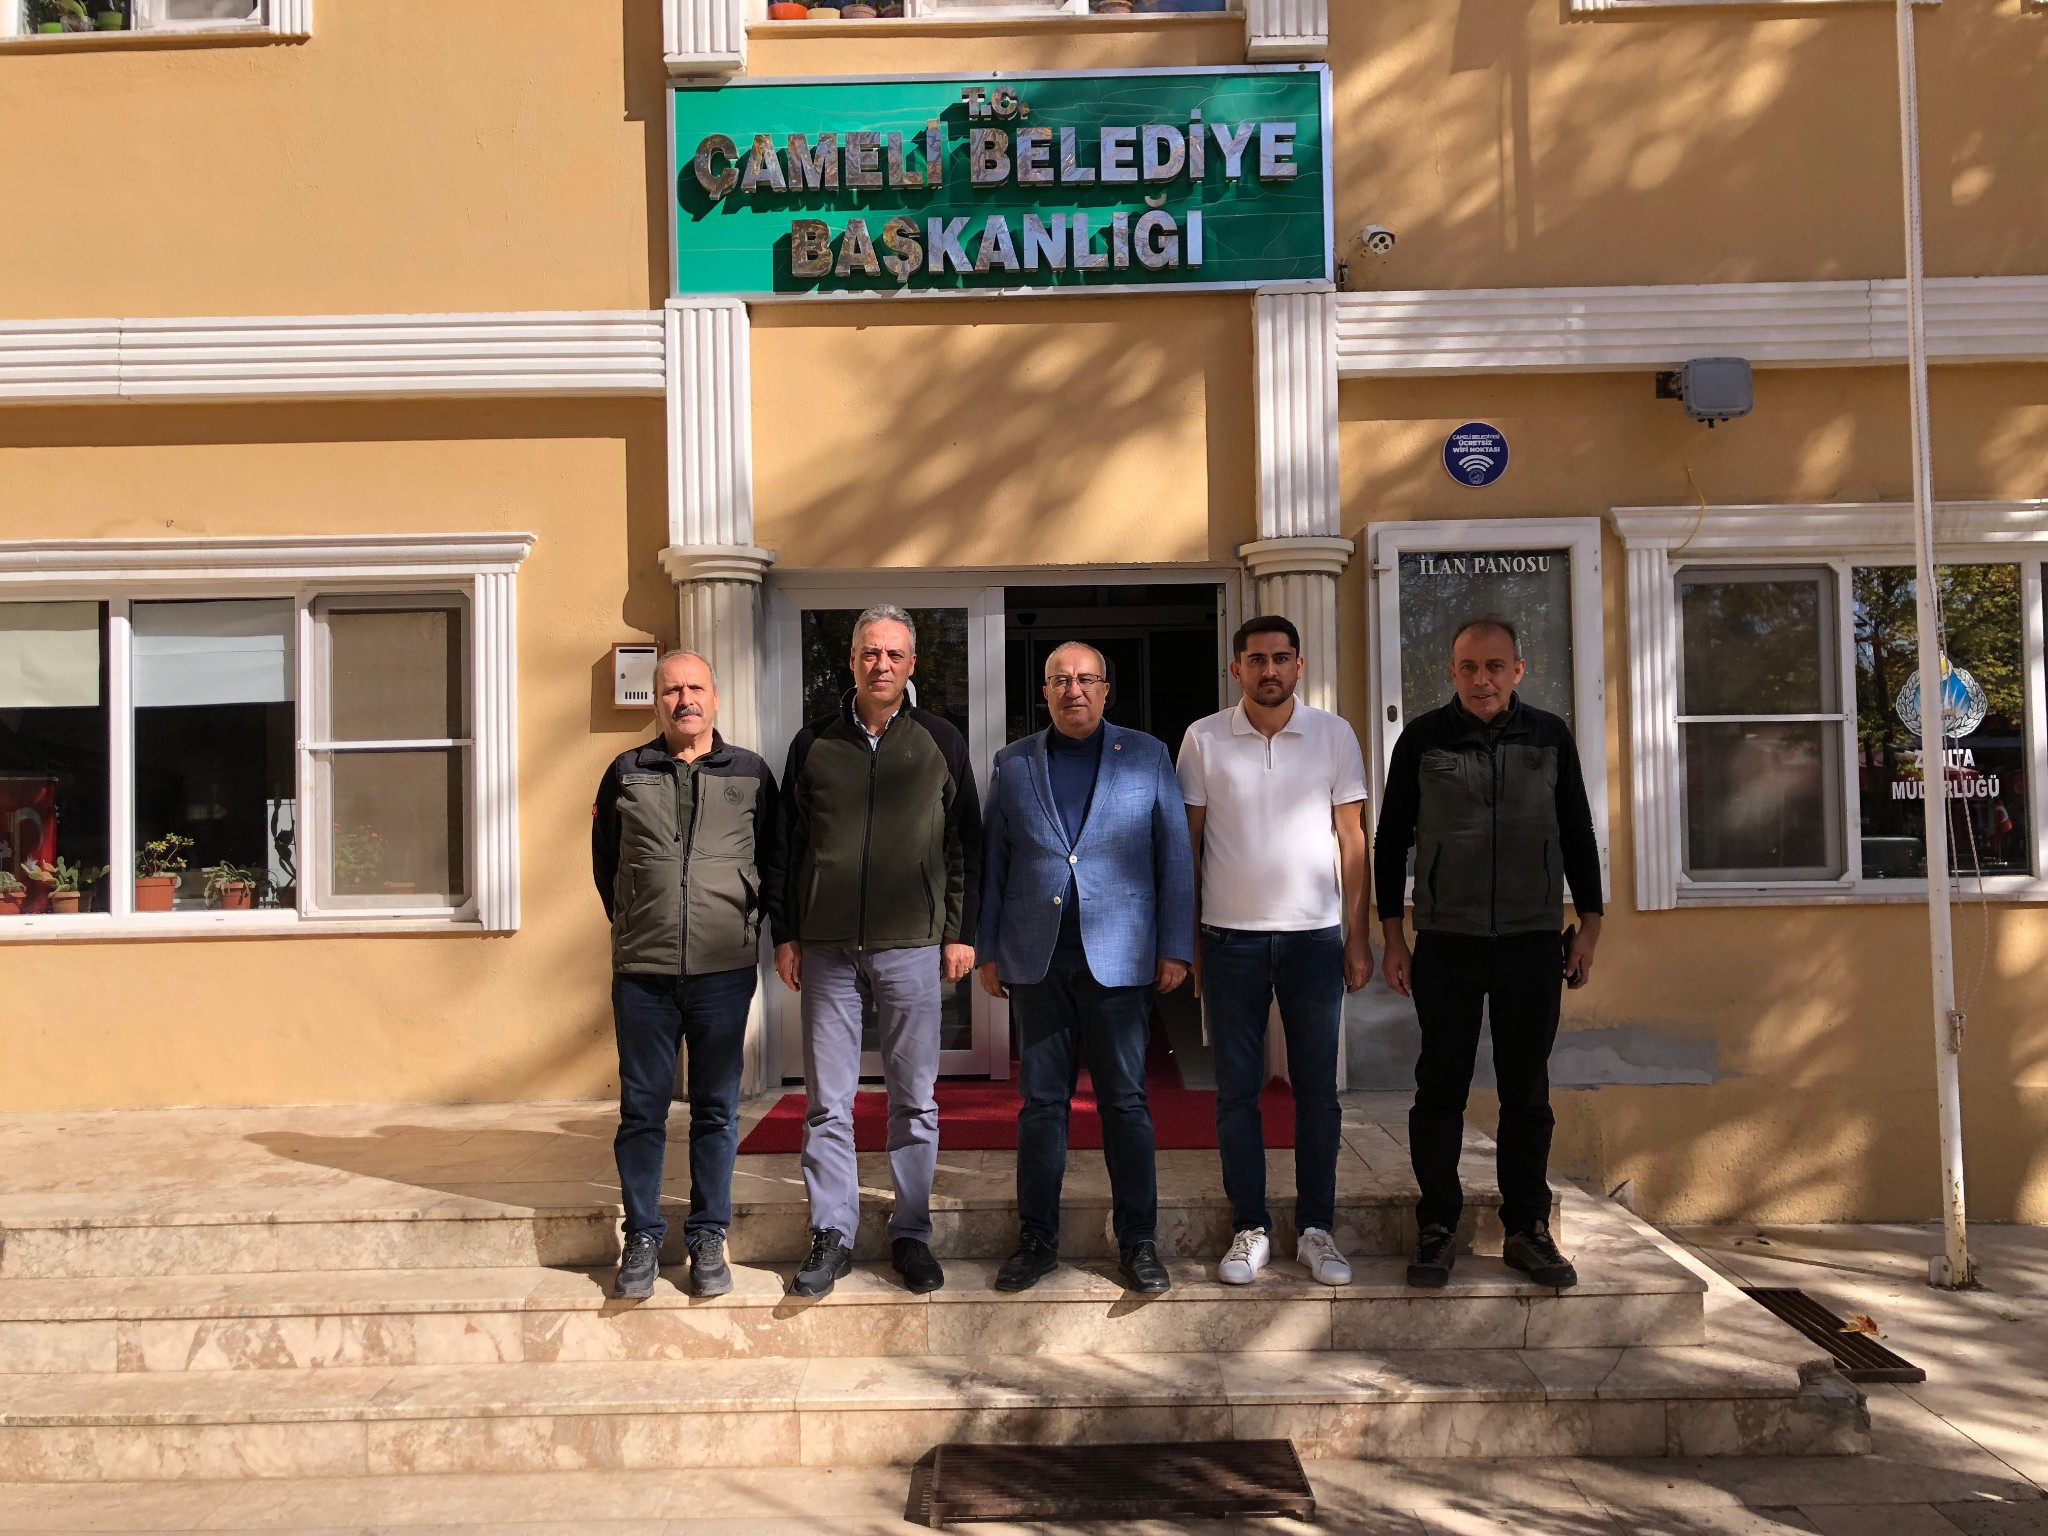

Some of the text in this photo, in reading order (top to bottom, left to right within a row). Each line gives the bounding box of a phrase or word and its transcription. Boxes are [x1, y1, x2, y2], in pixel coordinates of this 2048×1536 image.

[960, 85, 1030, 121] T.C.
[694, 108, 1298, 200] ÇAMELİ BELEDİYE
[790, 193, 1204, 283] BAŞKANLIĞI
[1419, 555, 1551, 575] İLAN PANOSU
